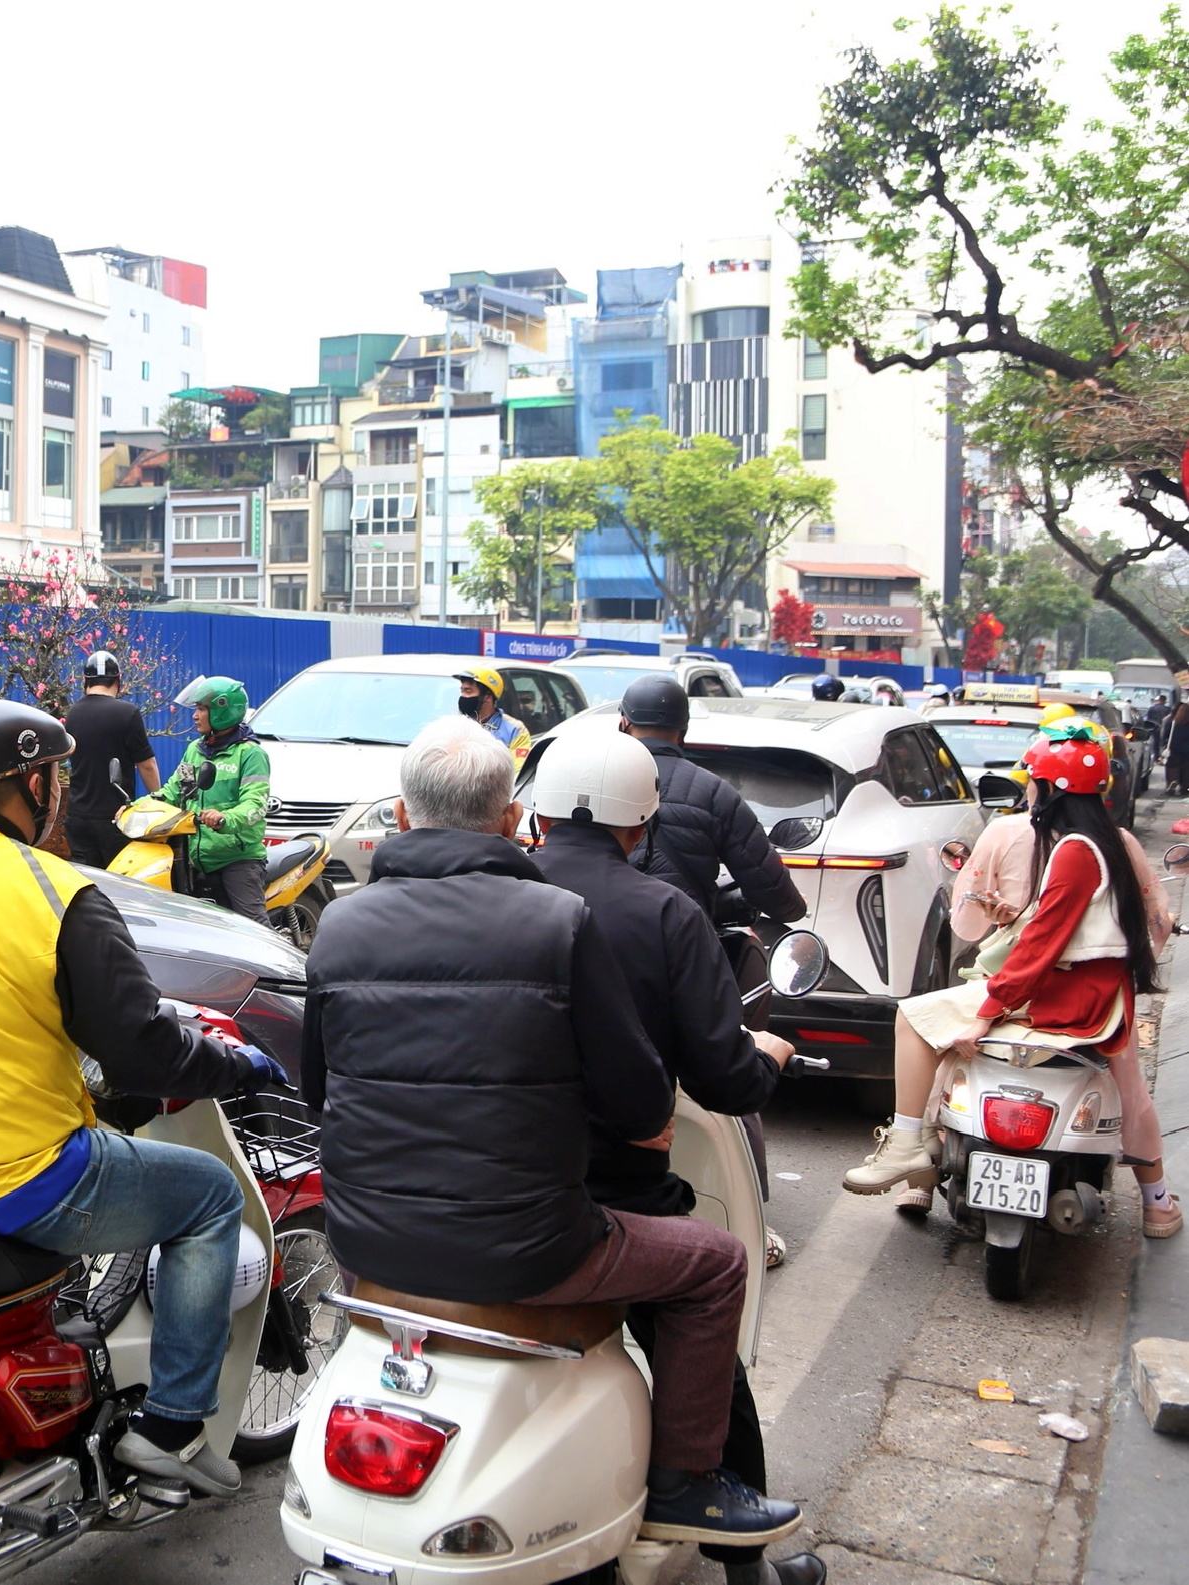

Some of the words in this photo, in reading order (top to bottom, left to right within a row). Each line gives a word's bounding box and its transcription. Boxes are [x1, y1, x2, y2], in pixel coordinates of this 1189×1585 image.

[216, 761, 238, 774] Grab
[980, 1157, 1036, 1185] 29-AB
[972, 1181, 1041, 1213] 215.20
